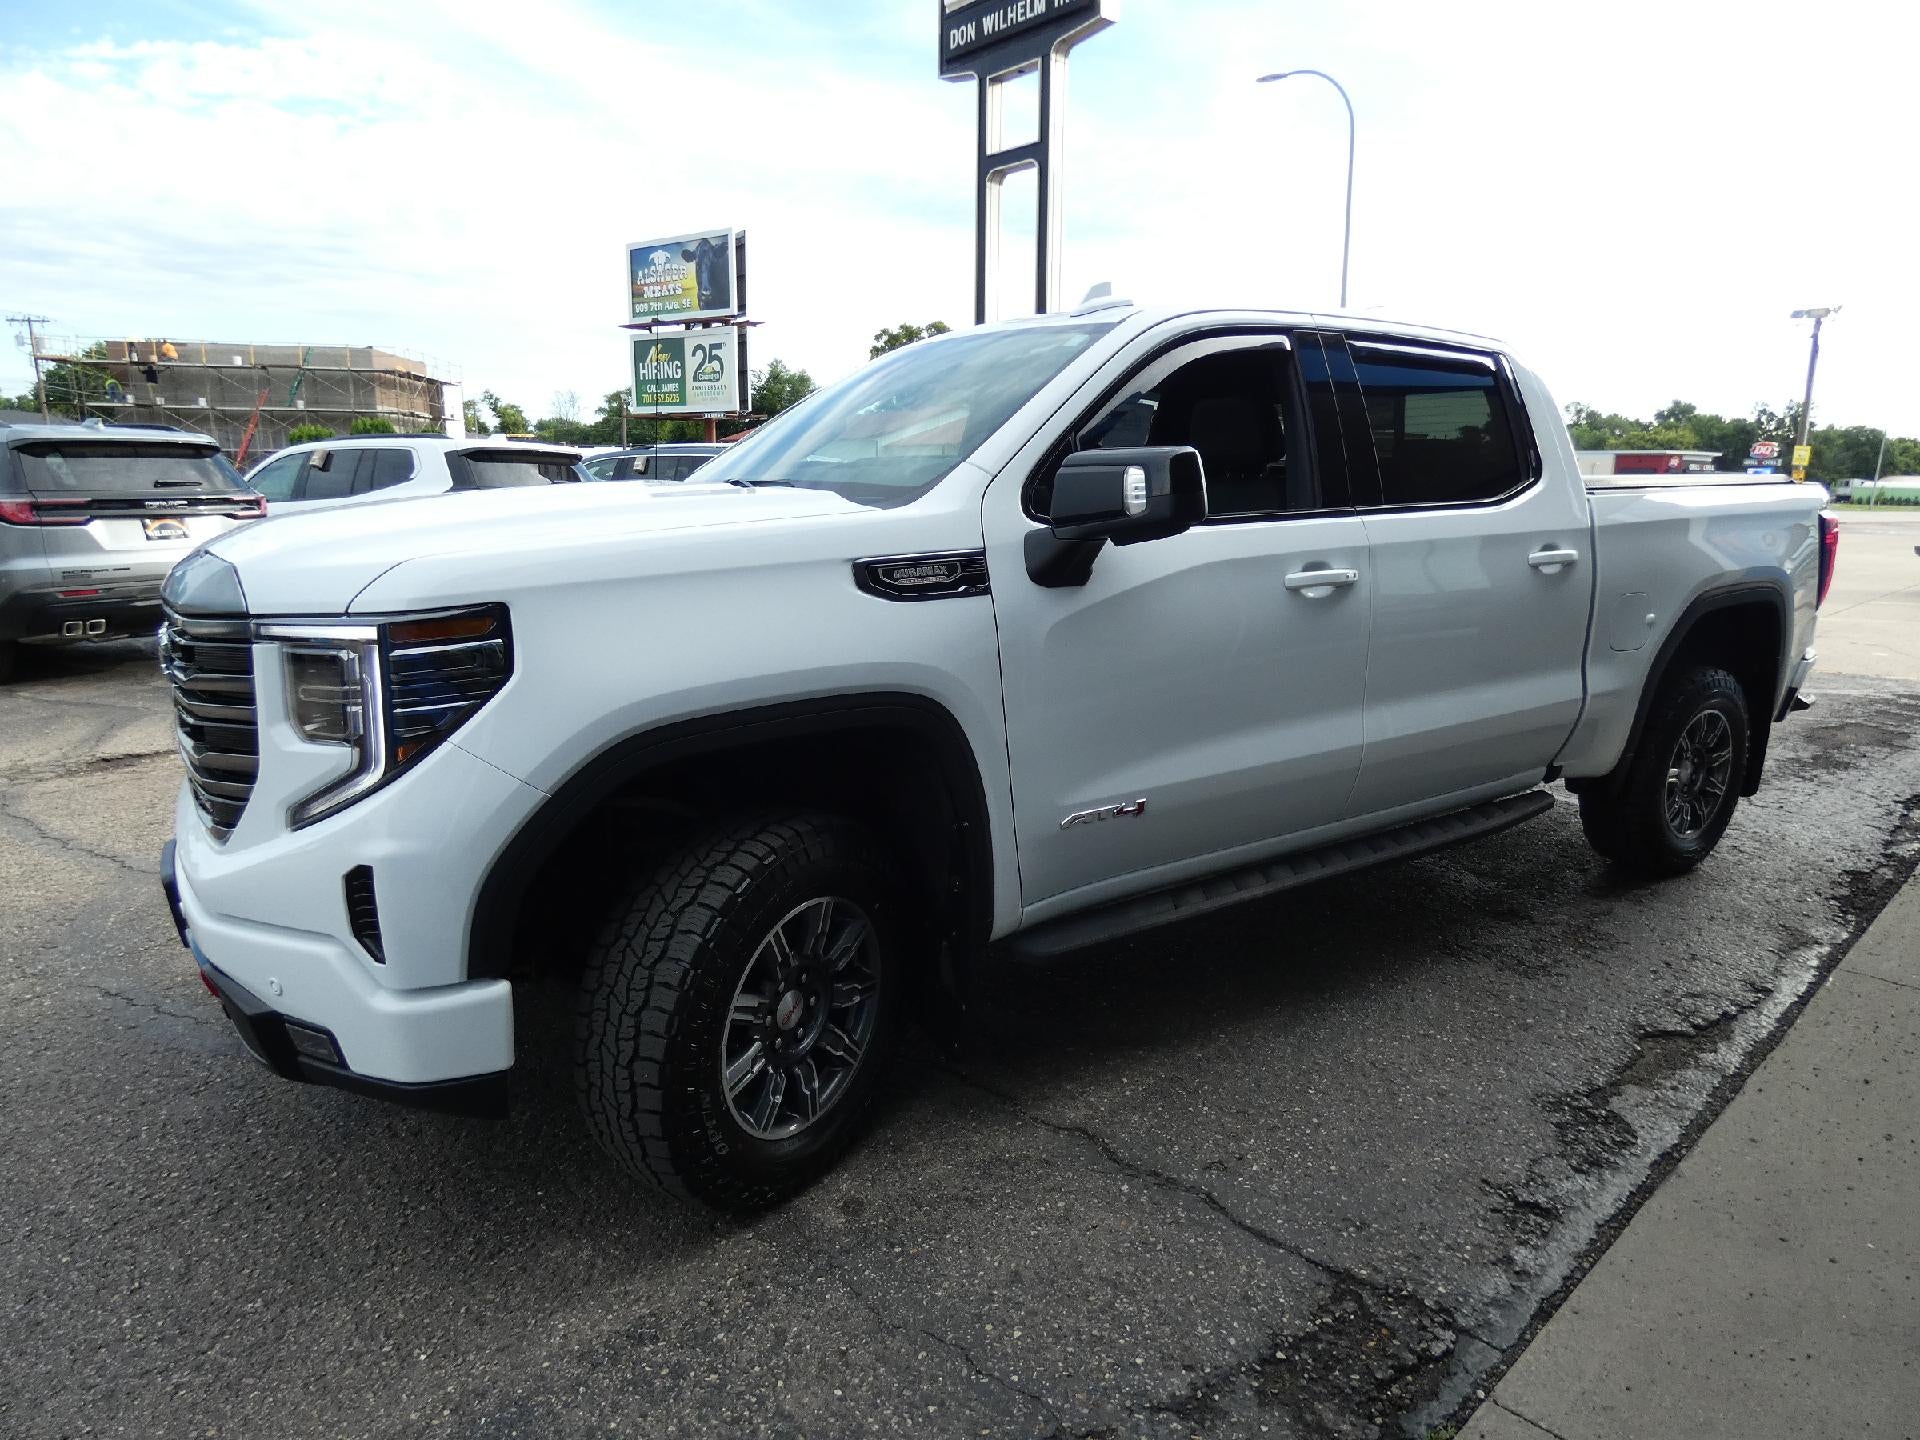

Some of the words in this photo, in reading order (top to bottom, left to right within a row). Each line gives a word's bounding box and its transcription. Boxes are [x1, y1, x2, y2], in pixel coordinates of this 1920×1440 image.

[949, 21, 977, 50] DON
[982, 0, 1046, 37] WILHELM
[643, 283, 683, 299] MEATS
[635, 303, 649, 313] 909
[650, 301, 663, 312] 7th
[682, 298, 692, 308] SE
[639, 360, 682, 380] HIRING
[662, 382, 680, 393] JAMES
[1753, 445, 1772, 456] DQ
[893, 565, 949, 578] DURAMAX
[1060, 797, 1147, 829] AT4
